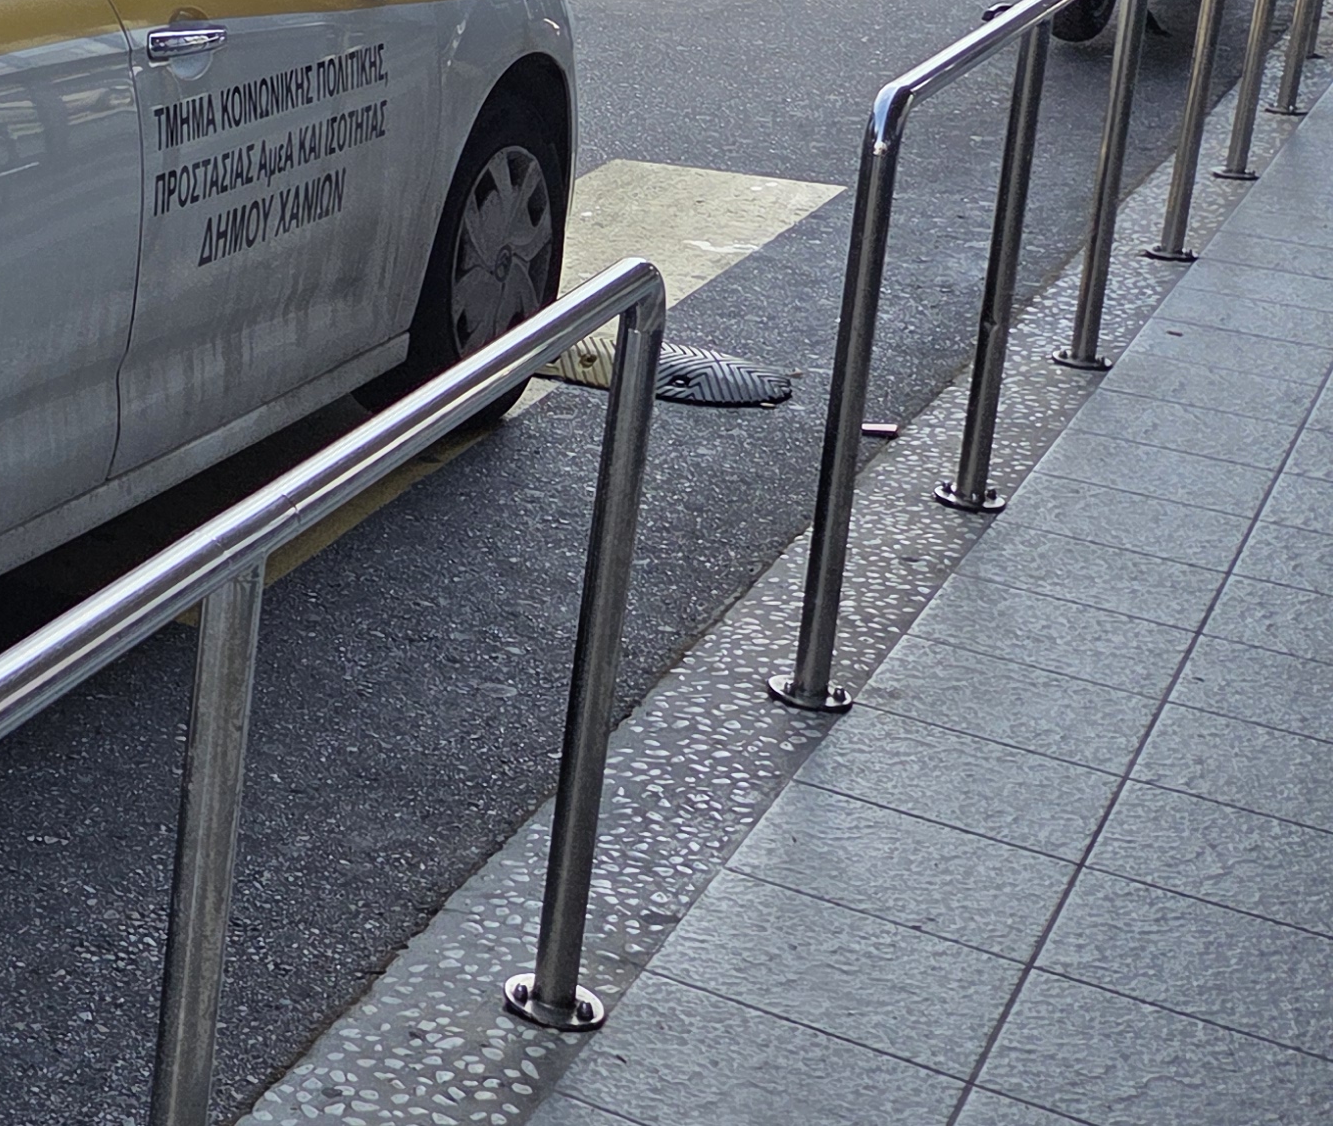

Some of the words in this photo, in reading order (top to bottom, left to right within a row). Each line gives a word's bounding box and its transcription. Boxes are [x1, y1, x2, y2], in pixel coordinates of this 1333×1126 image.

[154, 94, 218, 151] ΤΜΗΜΑ
[221, 65, 313, 131] ΚΟΙΝΩΝΙΚΗΣ
[153, 143, 255, 217] ΠΡΟΣΤΑΣΙΑΣ
[257, 132, 294, 187] ΑμεΑ
[297, 120, 324, 165] ΚΑΙ
[324, 100, 388, 156] ΙΣΟΤΗΤΑΣ
[198, 193, 275, 267] ΔΗΜΟΥ
[275, 168, 346, 237] ΧΑΝΙΩΝ
